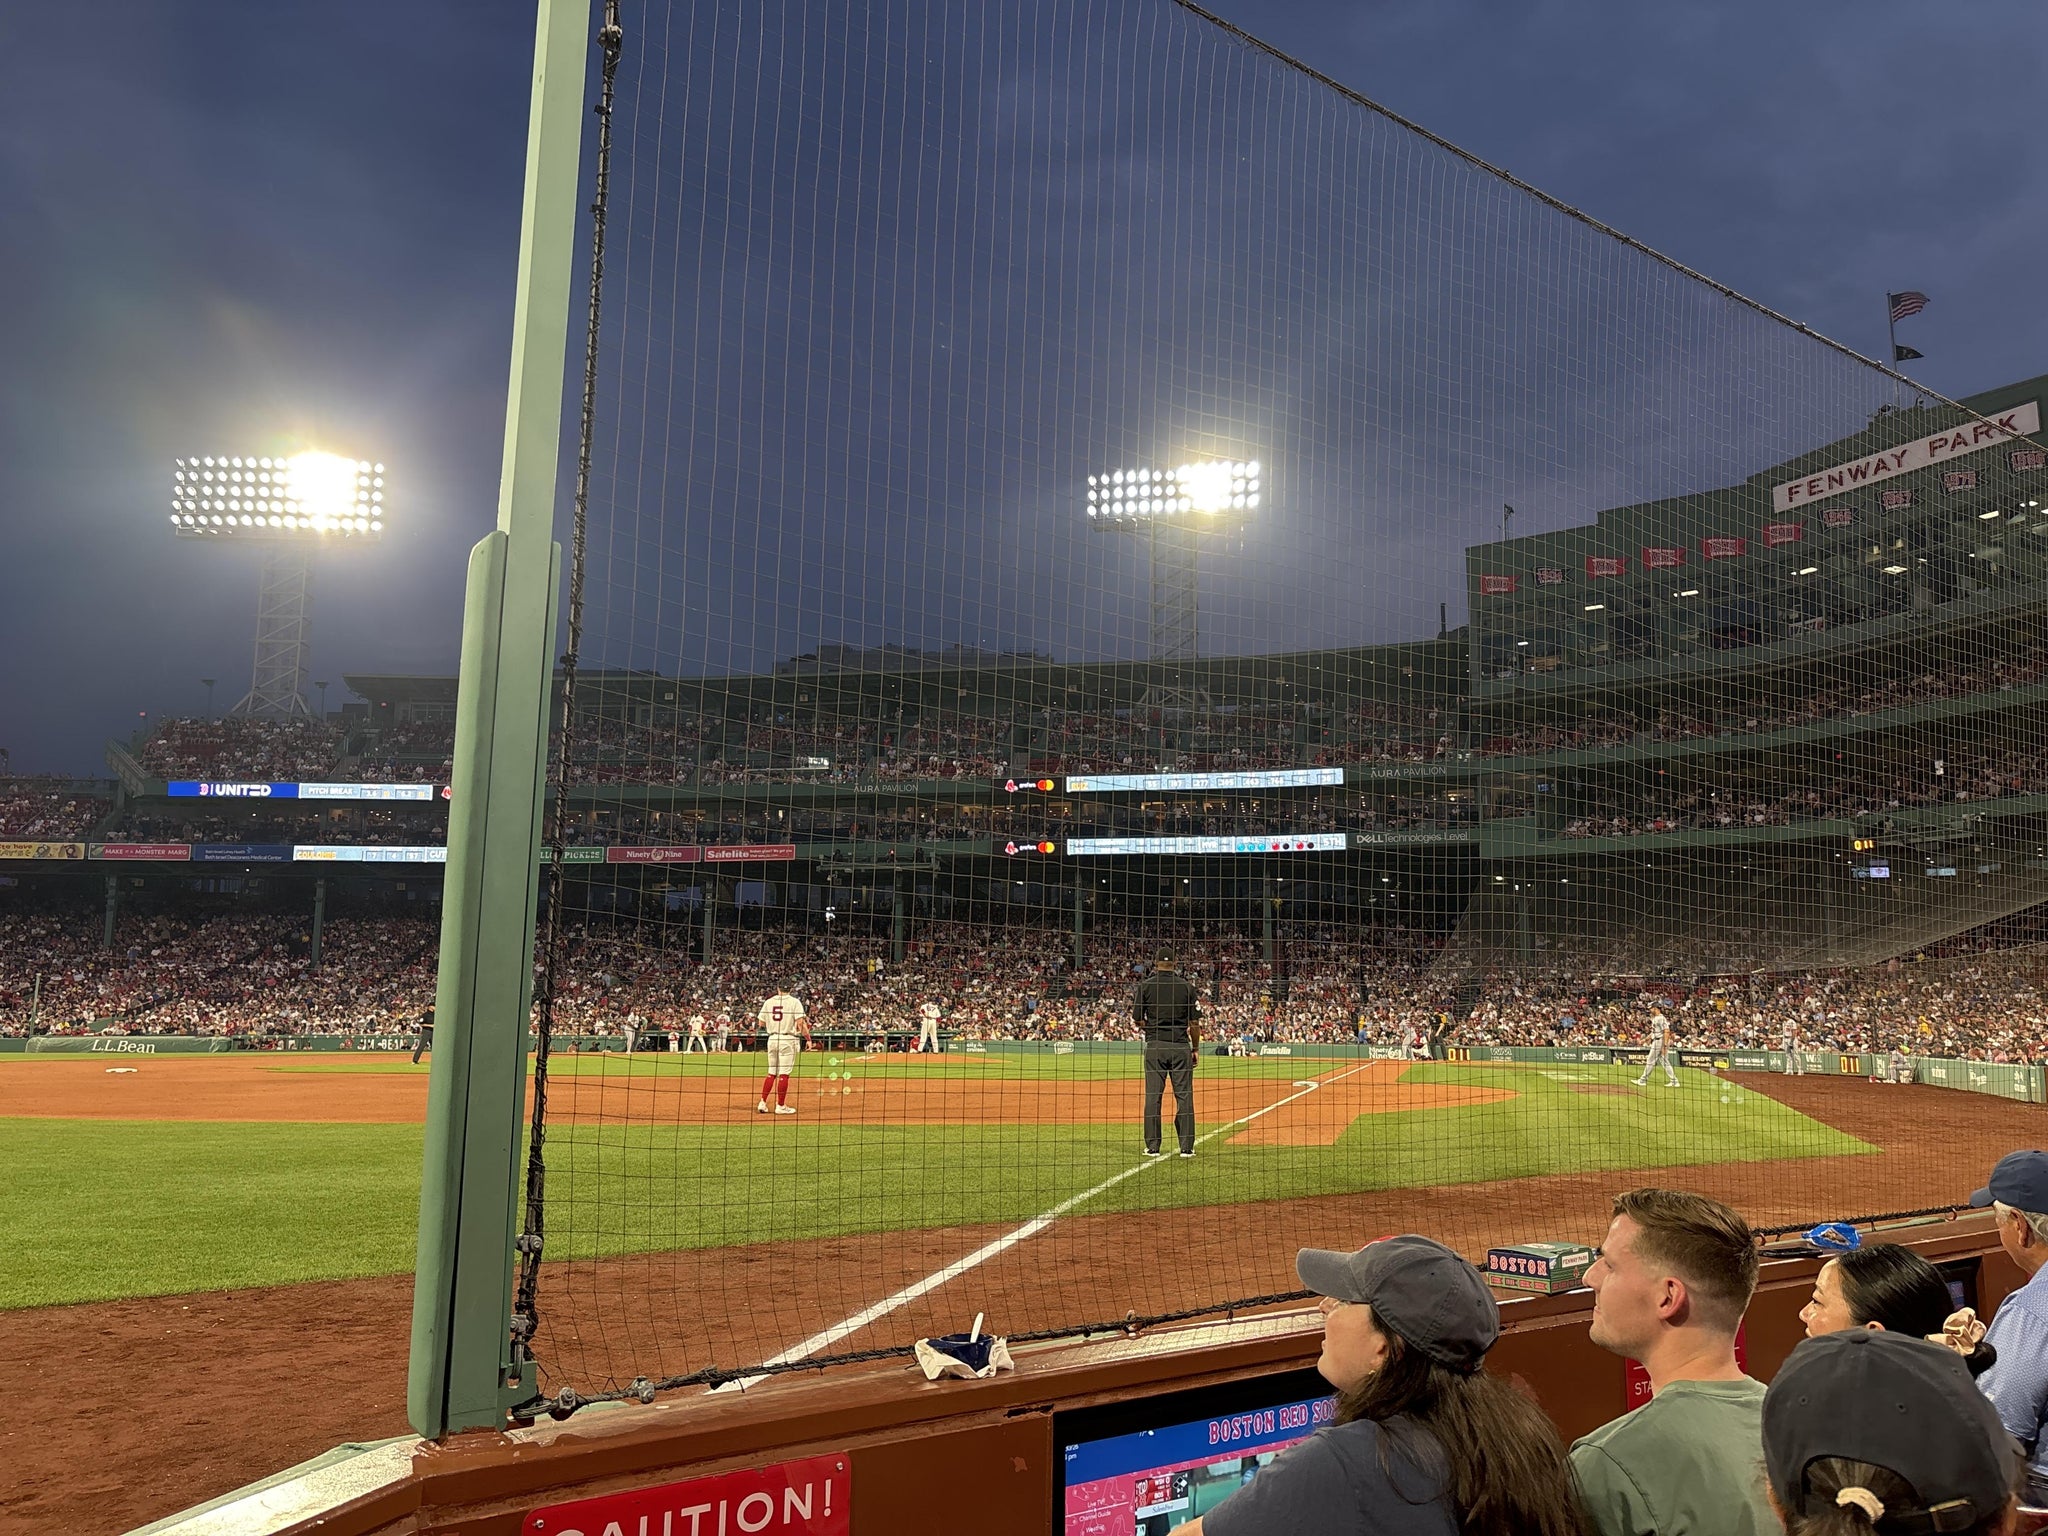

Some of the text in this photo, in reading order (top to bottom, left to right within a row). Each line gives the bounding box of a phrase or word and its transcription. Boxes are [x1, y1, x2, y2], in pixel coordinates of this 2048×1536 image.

[1787, 414, 2019, 503] FENWAY PARK
[1403, 766, 1447, 776] PAVILION
[215, 784, 272, 797] UNITED
[308, 787, 329, 795] PITCH
[330, 787, 353, 795] BREAK
[882, 784, 918, 792] PAVILION
[1356, 831, 1468, 844] DELL Technologies Level
[1854, 840, 1874, 850] 011
[626, 851, 651, 859] Ninety
[707, 850, 750, 859] Safelite
[771, 1006, 784, 1021] 5
[91, 1039, 156, 1053] L.L.Bean
[1260, 1045, 1292, 1055] Franklin
[1448, 1048, 1470, 1061] 011
[1581, 1051, 1605, 1062] jetBlue
[1840, 1056, 1860, 1073] 011
[1490, 1255, 1548, 1276] BOSTON
[1562, 1256, 1577, 1265] FENWAY
[1209, 1410, 1275, 1445] BOSTON
[1279, 1403, 1309, 1430] RED
[554, 1478, 832, 1536] UTION!
[1079, 1510, 1111, 1522] Channel Guide
